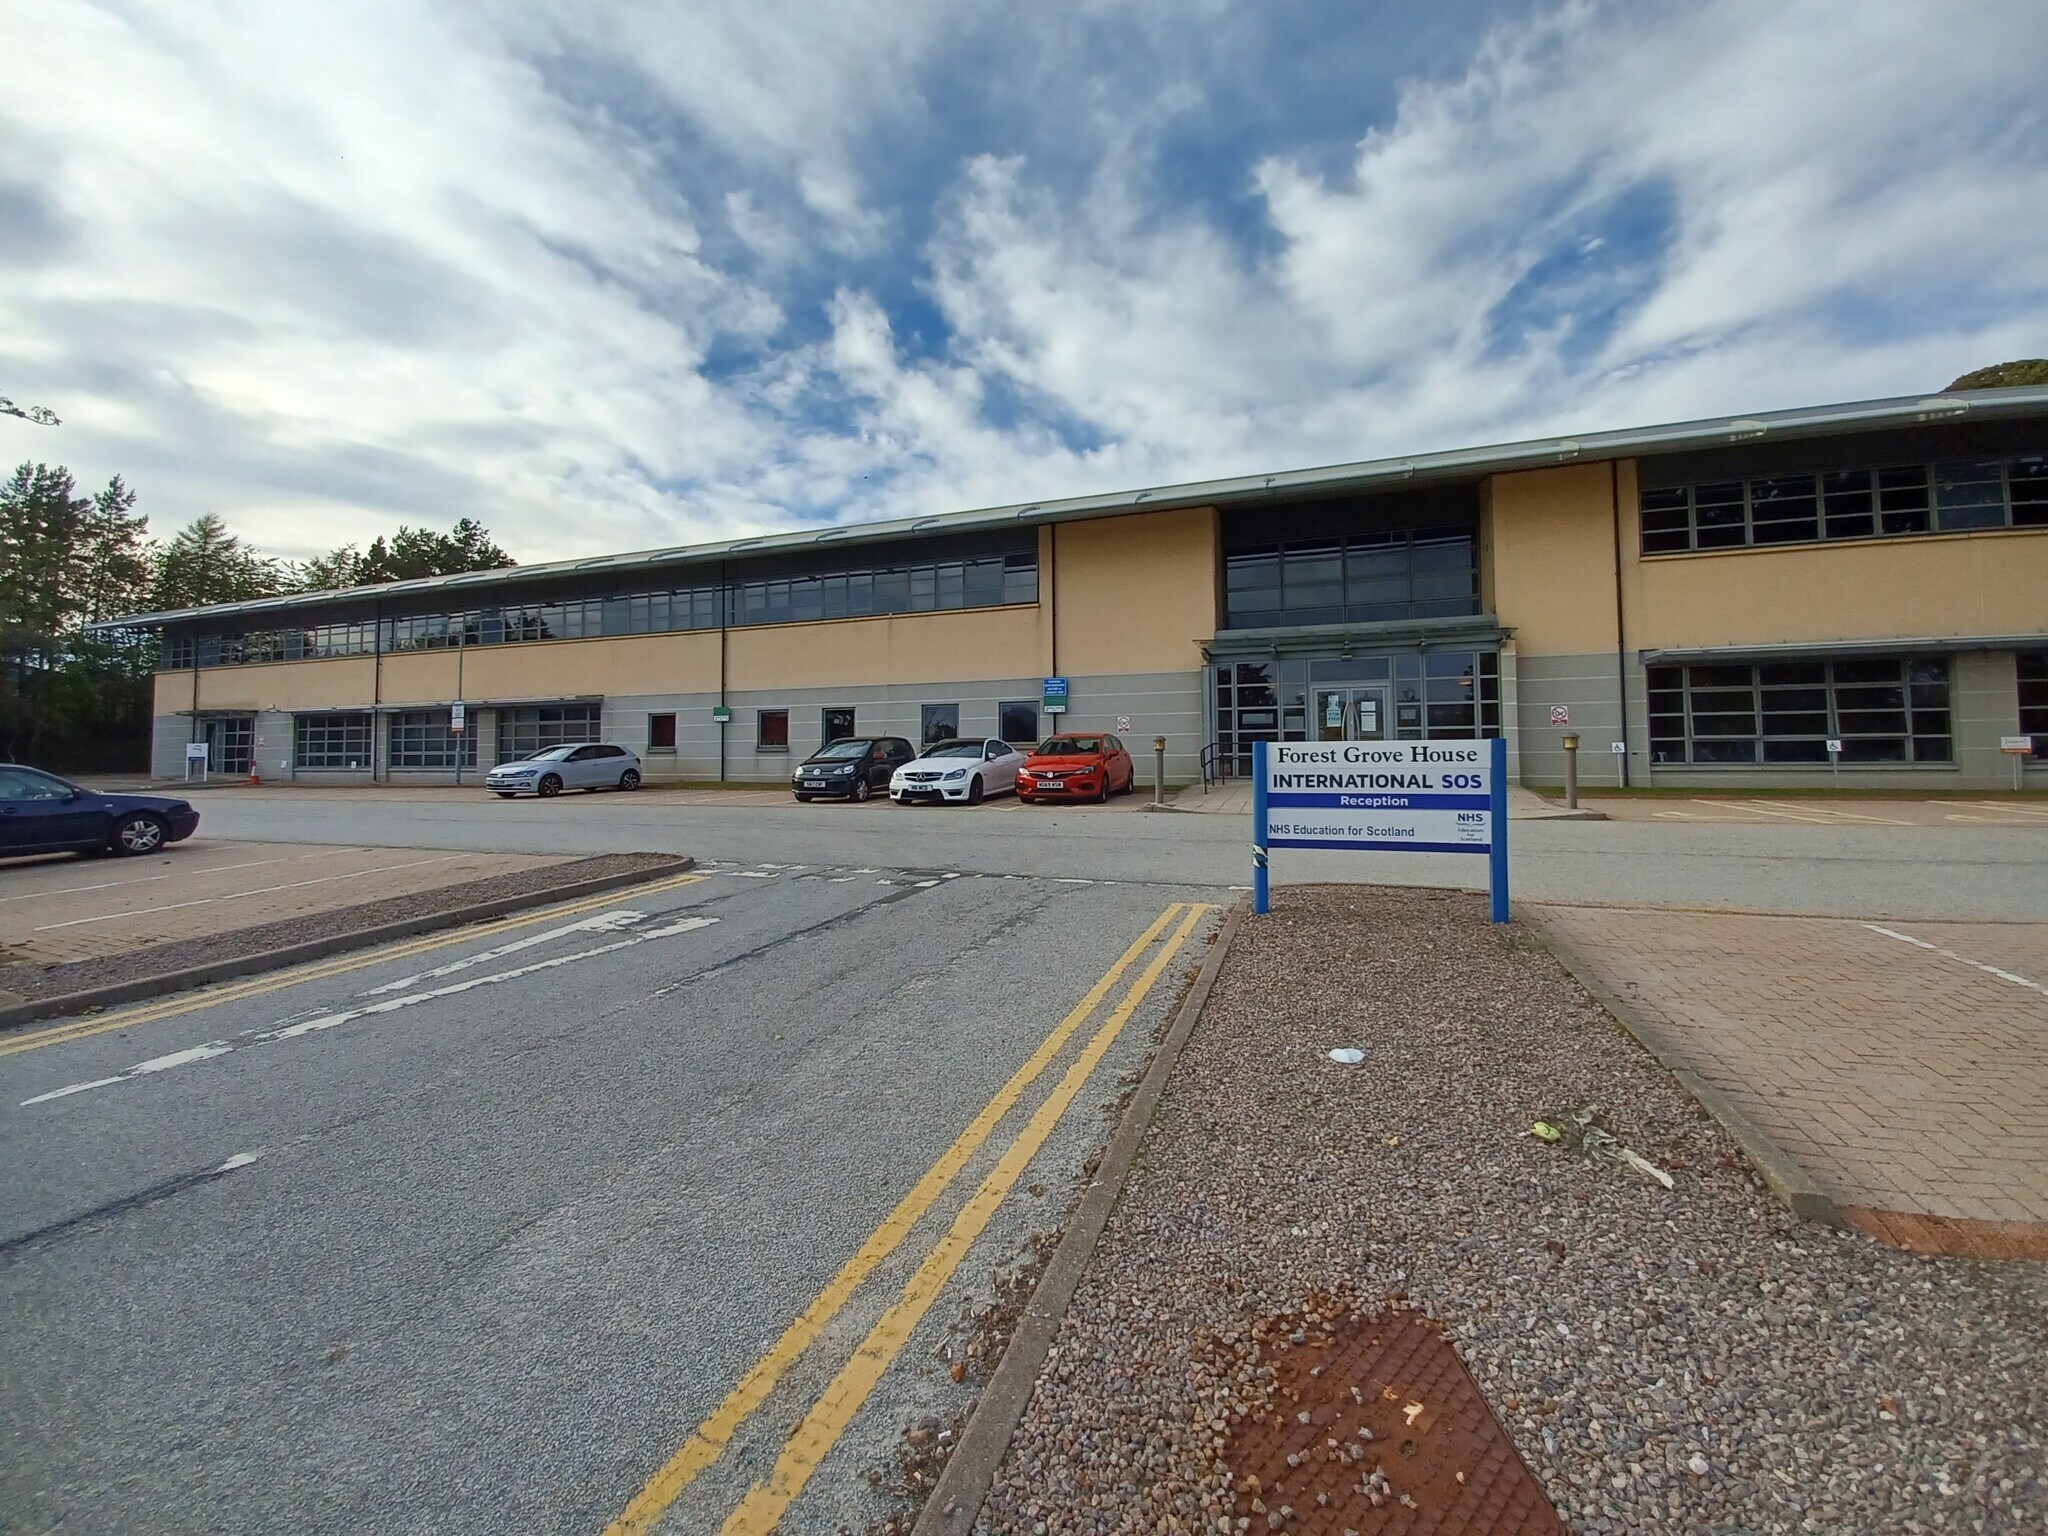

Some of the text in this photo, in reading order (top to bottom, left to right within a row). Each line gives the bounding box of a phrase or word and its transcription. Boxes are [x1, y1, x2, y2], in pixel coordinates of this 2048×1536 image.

[1277, 745, 1478, 763] Forest Grove House
[1273, 774, 1482, 789] INTERNATIONAL SOS
[1340, 795, 1409, 808] Reception
[1457, 813, 1484, 822] NHS
[1269, 824, 1415, 837] NHS Education for Scotland
